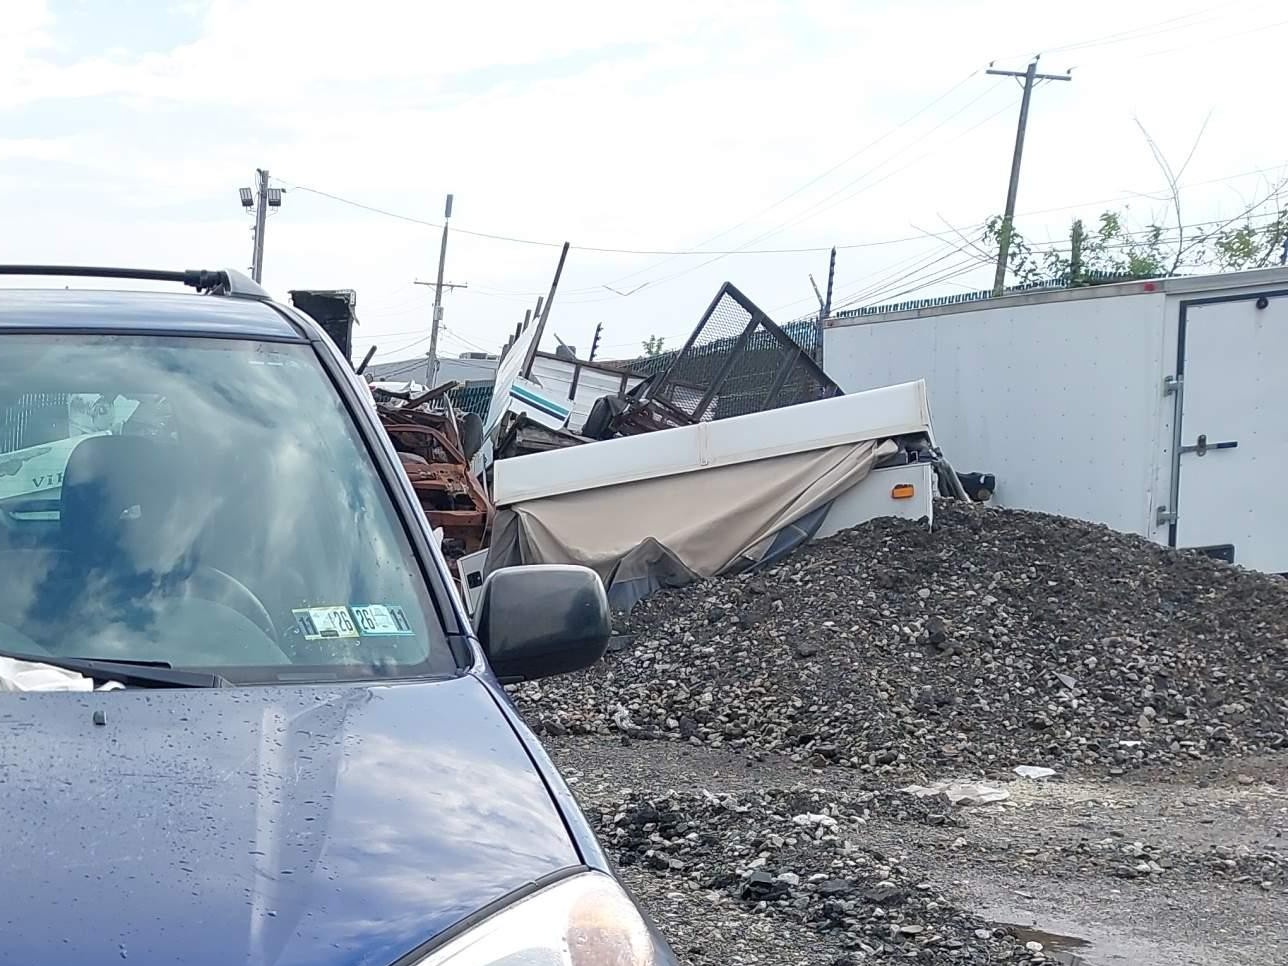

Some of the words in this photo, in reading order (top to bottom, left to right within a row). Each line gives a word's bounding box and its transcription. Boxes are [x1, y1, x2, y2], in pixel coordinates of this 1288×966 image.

[299, 615, 318, 636] 11
[333, 610, 354, 632] 26
[356, 608, 376, 631] 26
